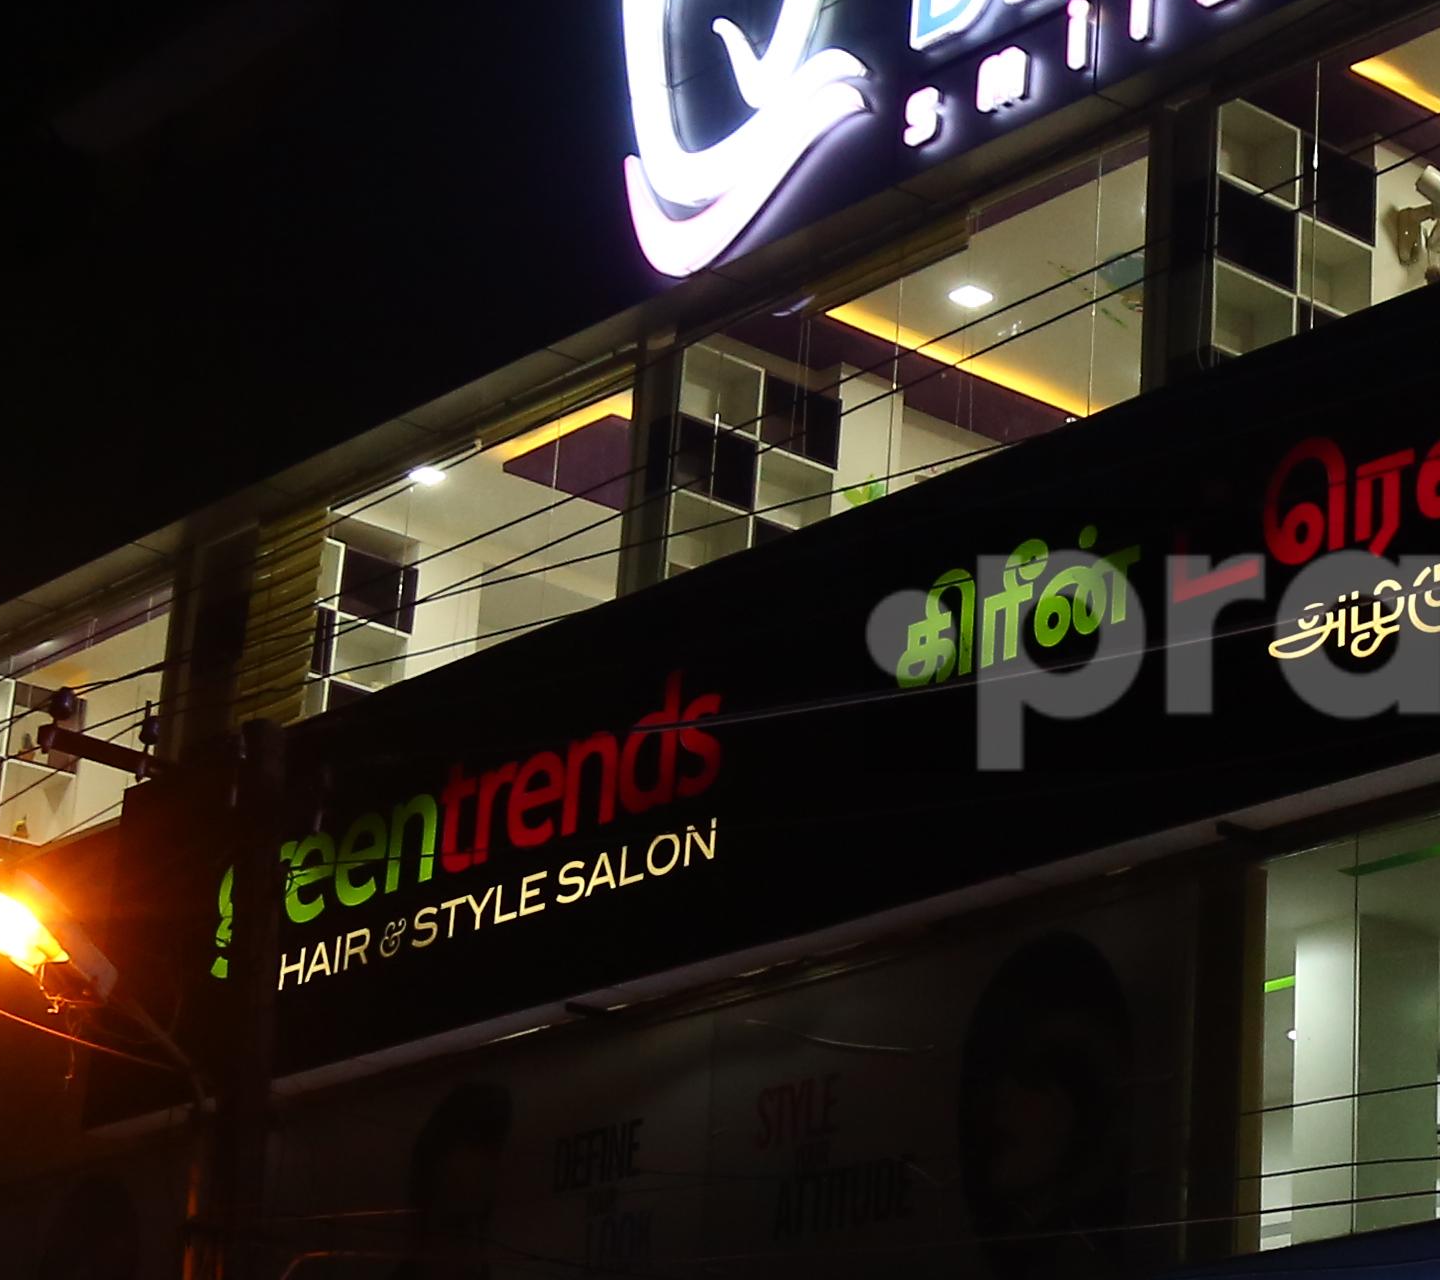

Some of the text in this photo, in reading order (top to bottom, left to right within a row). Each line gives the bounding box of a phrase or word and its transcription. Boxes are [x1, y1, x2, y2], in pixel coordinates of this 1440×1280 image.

[278, 817, 718, 991] HAIR & STYLE SALON
